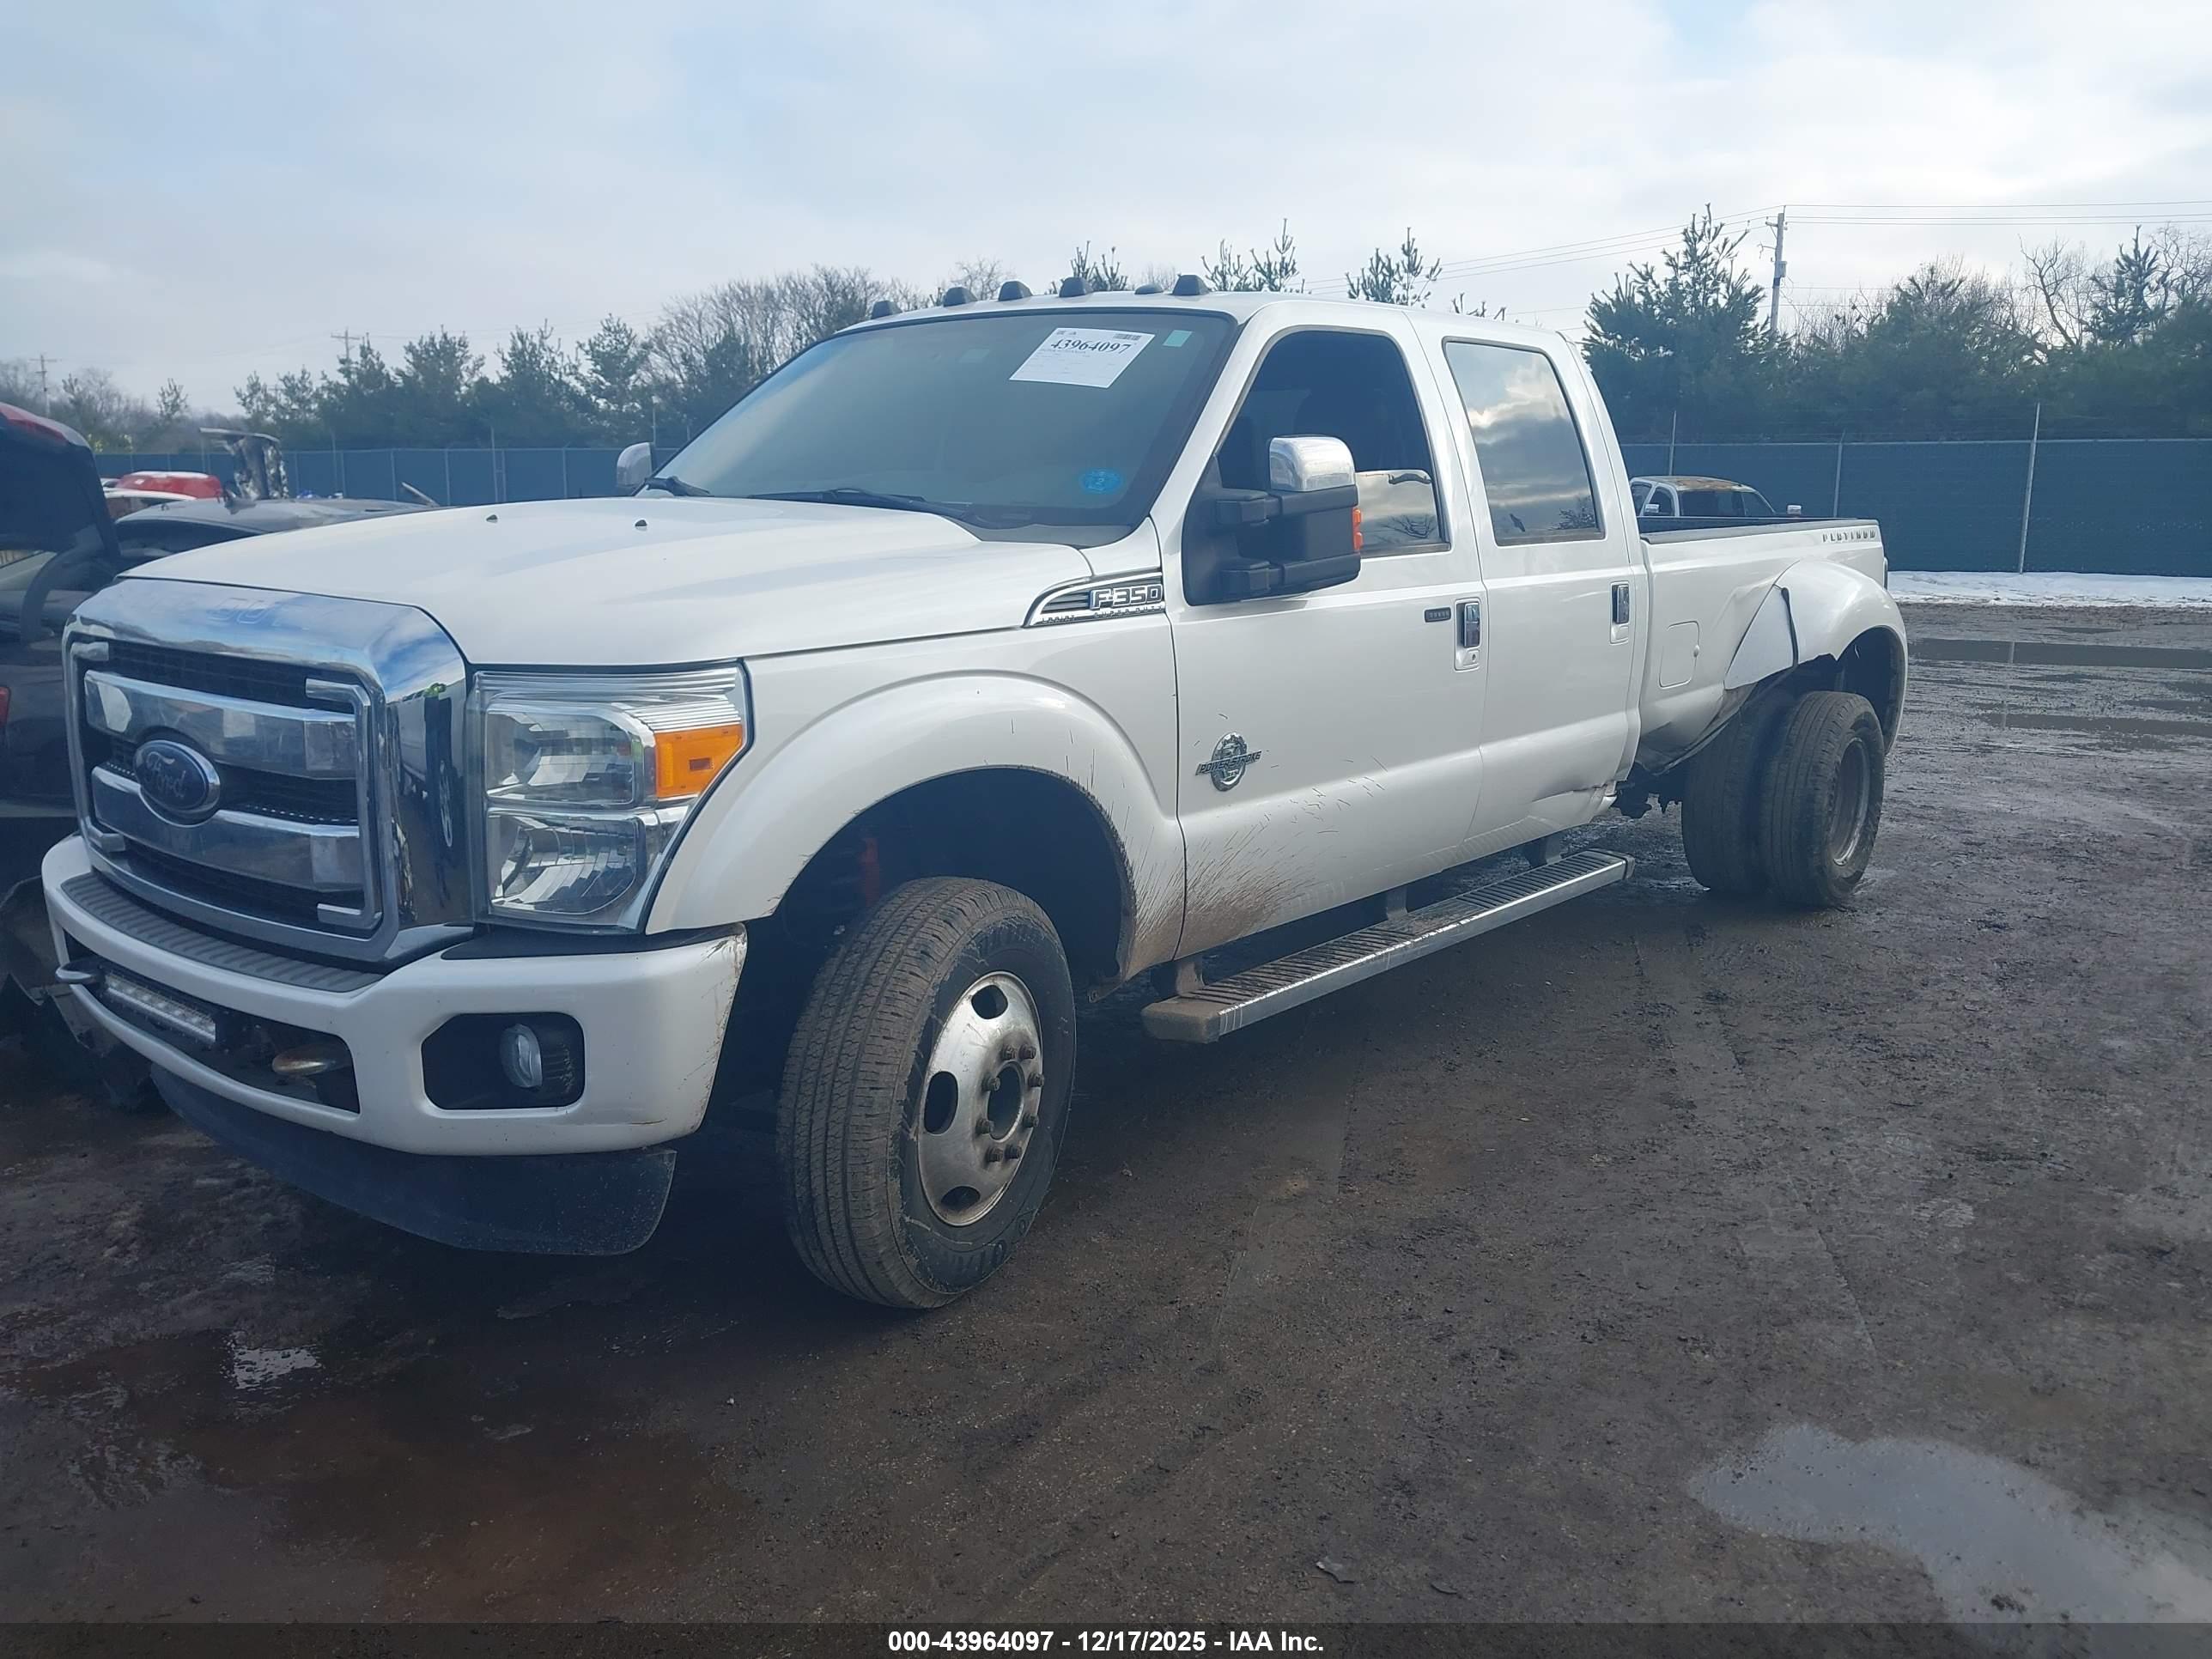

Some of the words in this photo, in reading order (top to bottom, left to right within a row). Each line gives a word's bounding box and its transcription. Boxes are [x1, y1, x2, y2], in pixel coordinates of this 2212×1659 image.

[1050, 337, 1131, 355] 43964097
[1090, 584, 1164, 611] F-350
[145, 750, 186, 799] Ford
